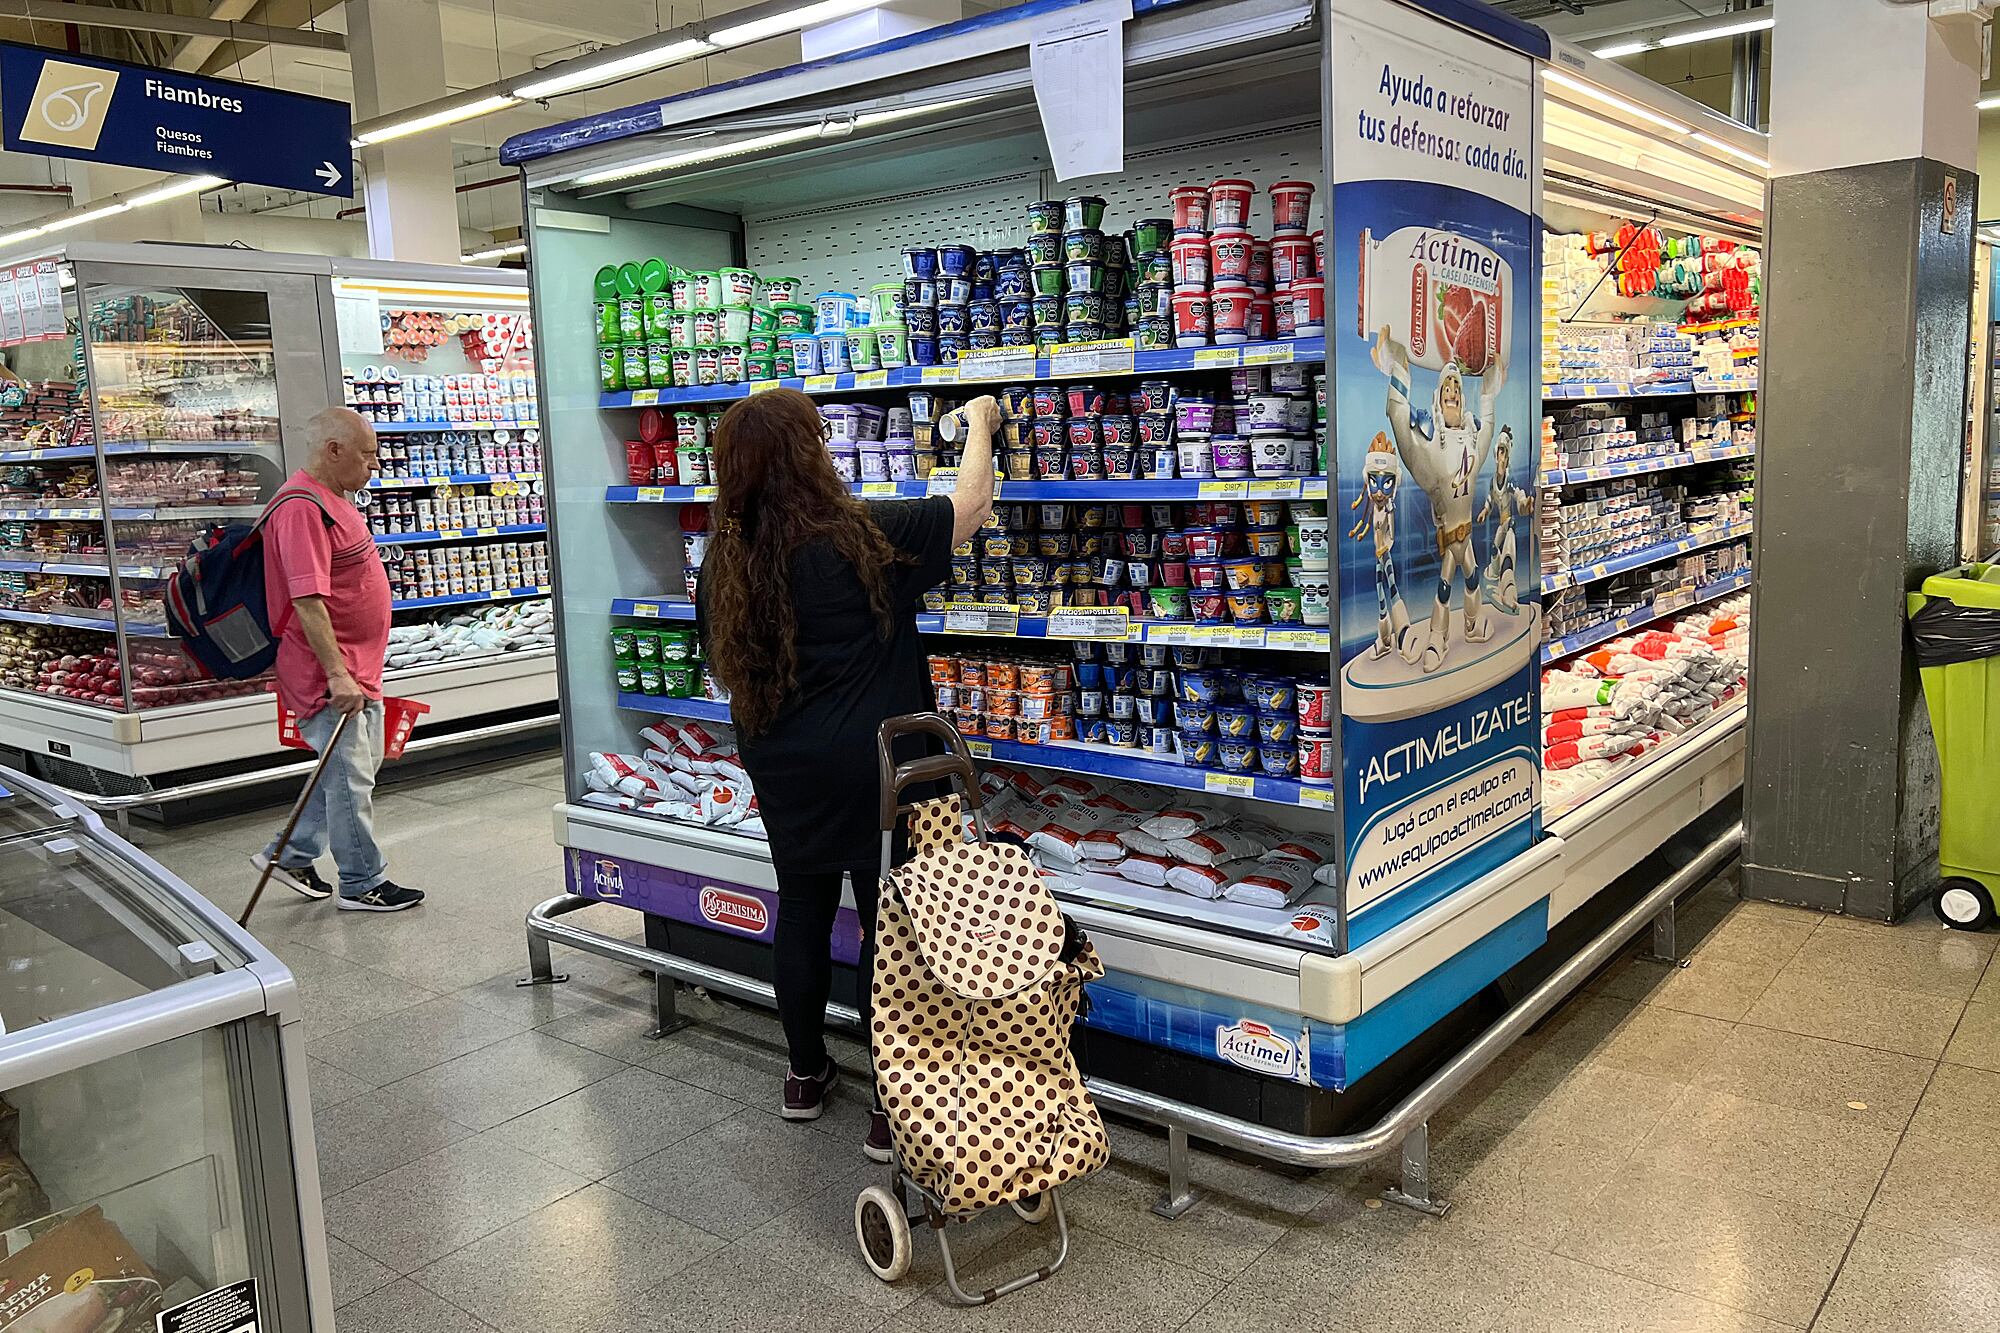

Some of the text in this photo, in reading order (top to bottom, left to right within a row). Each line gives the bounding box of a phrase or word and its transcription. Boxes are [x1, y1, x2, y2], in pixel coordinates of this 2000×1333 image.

[145, 79, 243, 114] Fiambres
[1379, 64, 1509, 132] Ayuda a reforzar
[156, 126, 202, 143] Quesos
[156, 141, 213, 160] Fiambres
[1359, 109, 1527, 180] tus defensas cada día.
[1409, 232, 1500, 281] Actimel
[1441, 268, 1461, 283] CASEI
[1463, 274, 1494, 293] DEFENSIS
[1359, 692, 1531, 804] ¡ACTIMELIZATE!
[1383, 767, 1516, 845] Jugá con el equipo en
[594, 870, 624, 890] ACTIVIA
[1223, 1035, 1290, 1064] Actimel
[75, 1276, 81, 1284] 2
[6, 1286, 52, 1319] PIEL
